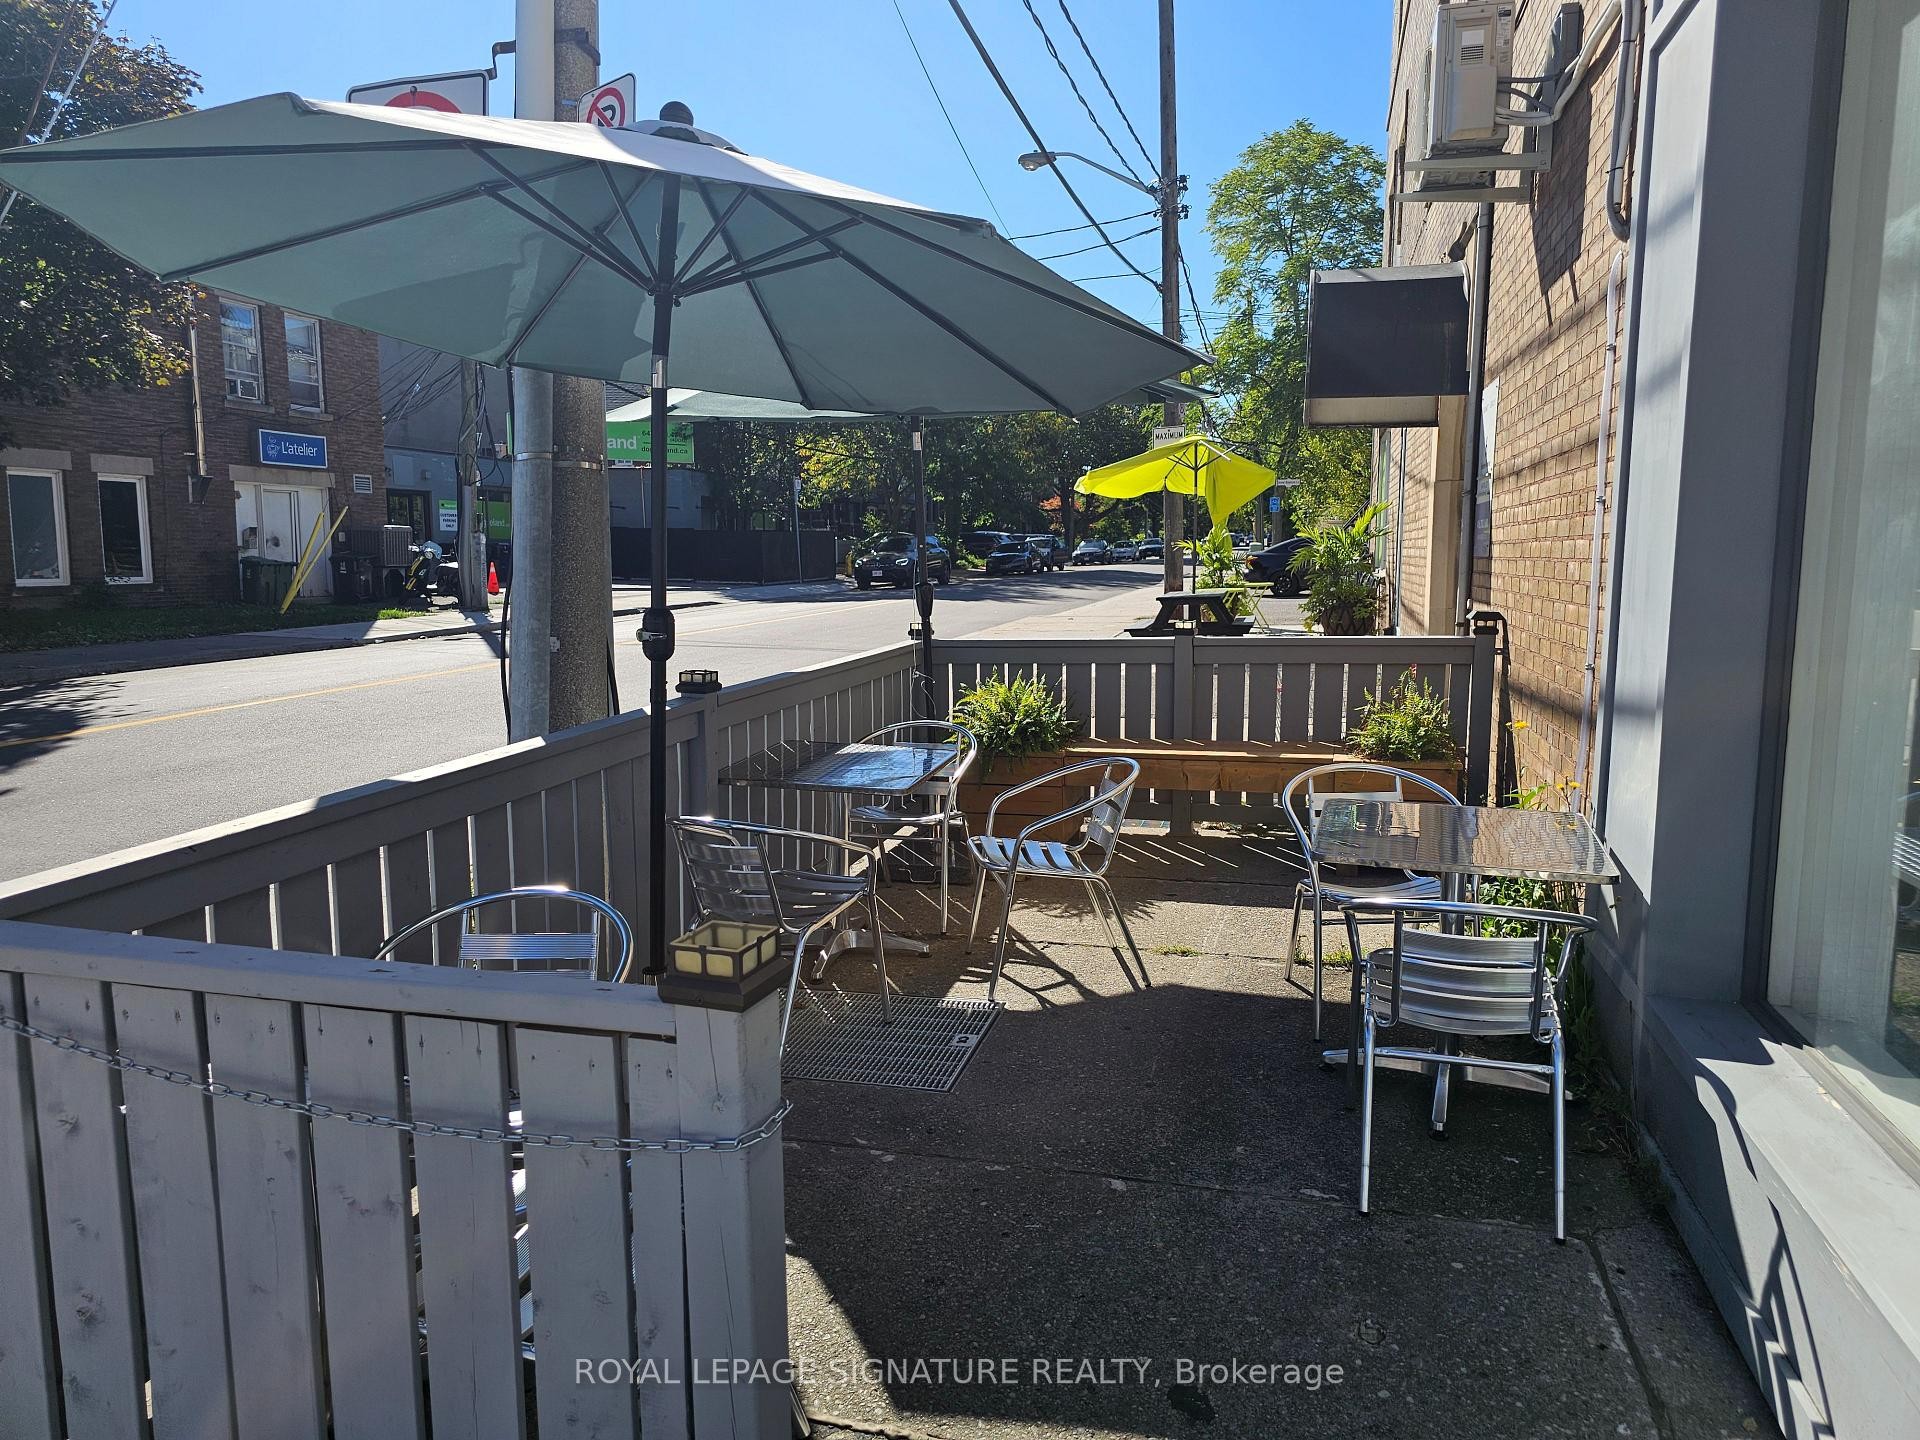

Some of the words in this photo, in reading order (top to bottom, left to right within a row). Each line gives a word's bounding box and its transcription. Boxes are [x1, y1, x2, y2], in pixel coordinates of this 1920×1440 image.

[607, 435, 637, 449] and
[1155, 431, 1183, 440] MAXIMUM
[281, 441, 318, 456] L'atelier
